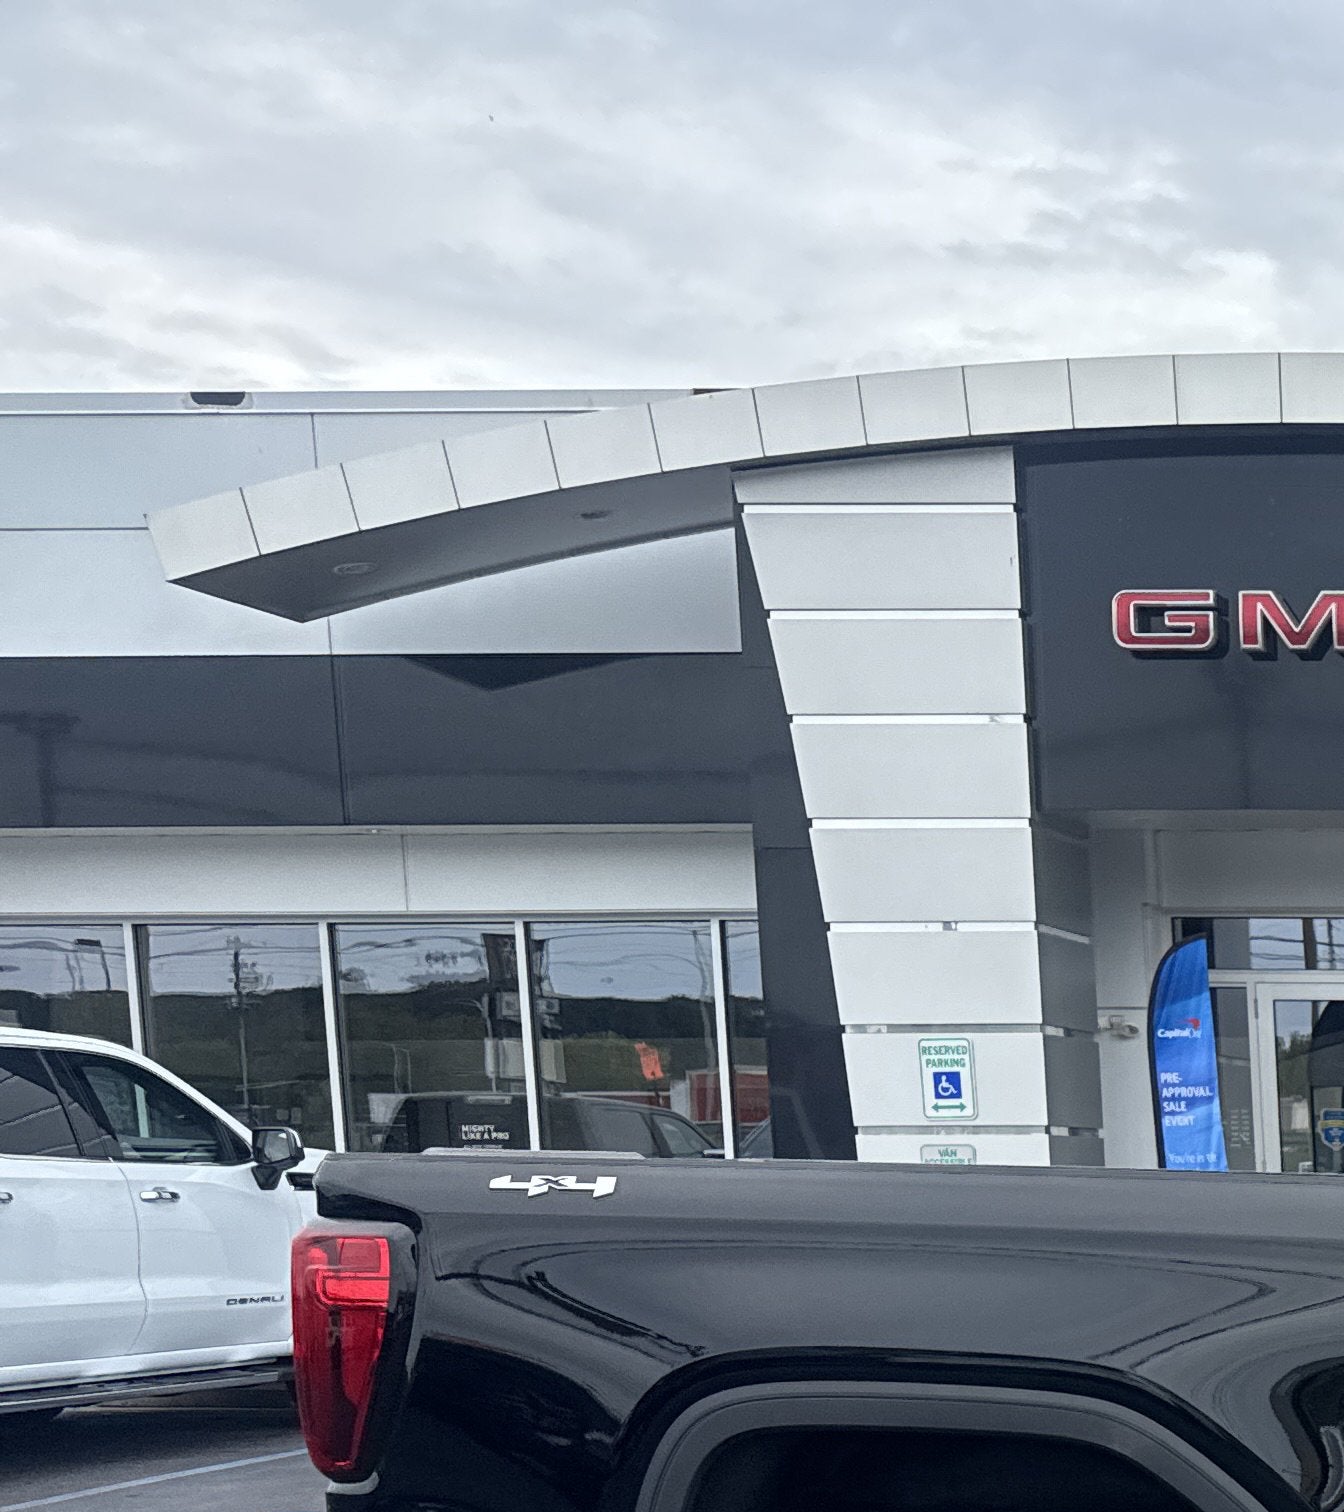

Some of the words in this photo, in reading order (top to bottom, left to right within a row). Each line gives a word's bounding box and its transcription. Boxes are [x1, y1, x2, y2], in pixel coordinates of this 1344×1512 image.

[921, 1045, 968, 1056] RESERVED
[925, 1058, 967, 1068] PARKING
[1160, 1072, 1183, 1084] PRE-
[1162, 1086, 1213, 1098] APPROVAL
[1163, 1101, 1187, 1113] SALE
[1165, 1115, 1195, 1127] EVENT
[462, 1124, 495, 1132] MIGHTY
[462, 1131, 481, 1140] LIKE
[483, 1131, 490, 1140] A
[491, 1131, 510, 1140] PRO
[938, 1147, 958, 1158] VAN
[226, 1294, 285, 1306] DENALI
